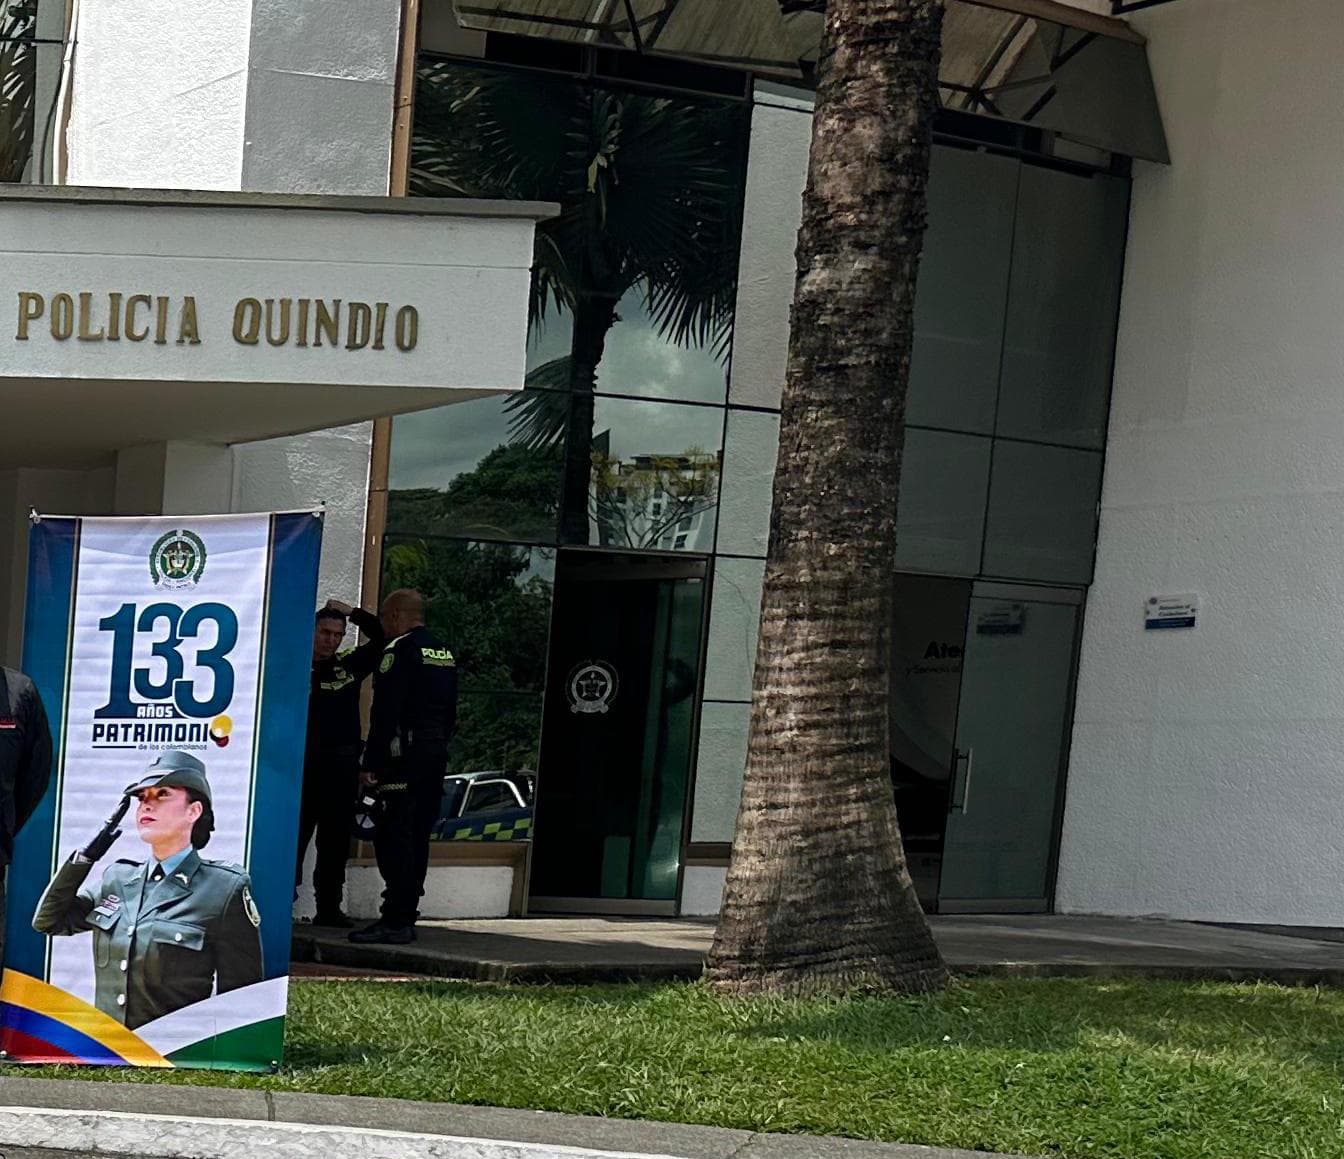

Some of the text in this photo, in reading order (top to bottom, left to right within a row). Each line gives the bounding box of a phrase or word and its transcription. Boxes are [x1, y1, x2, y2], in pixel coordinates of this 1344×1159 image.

[14, 291, 202, 345] POLICIA
[232, 296, 420, 353] QUINDIO
[94, 602, 239, 719] 133
[136, 703, 173, 718] AÑOS
